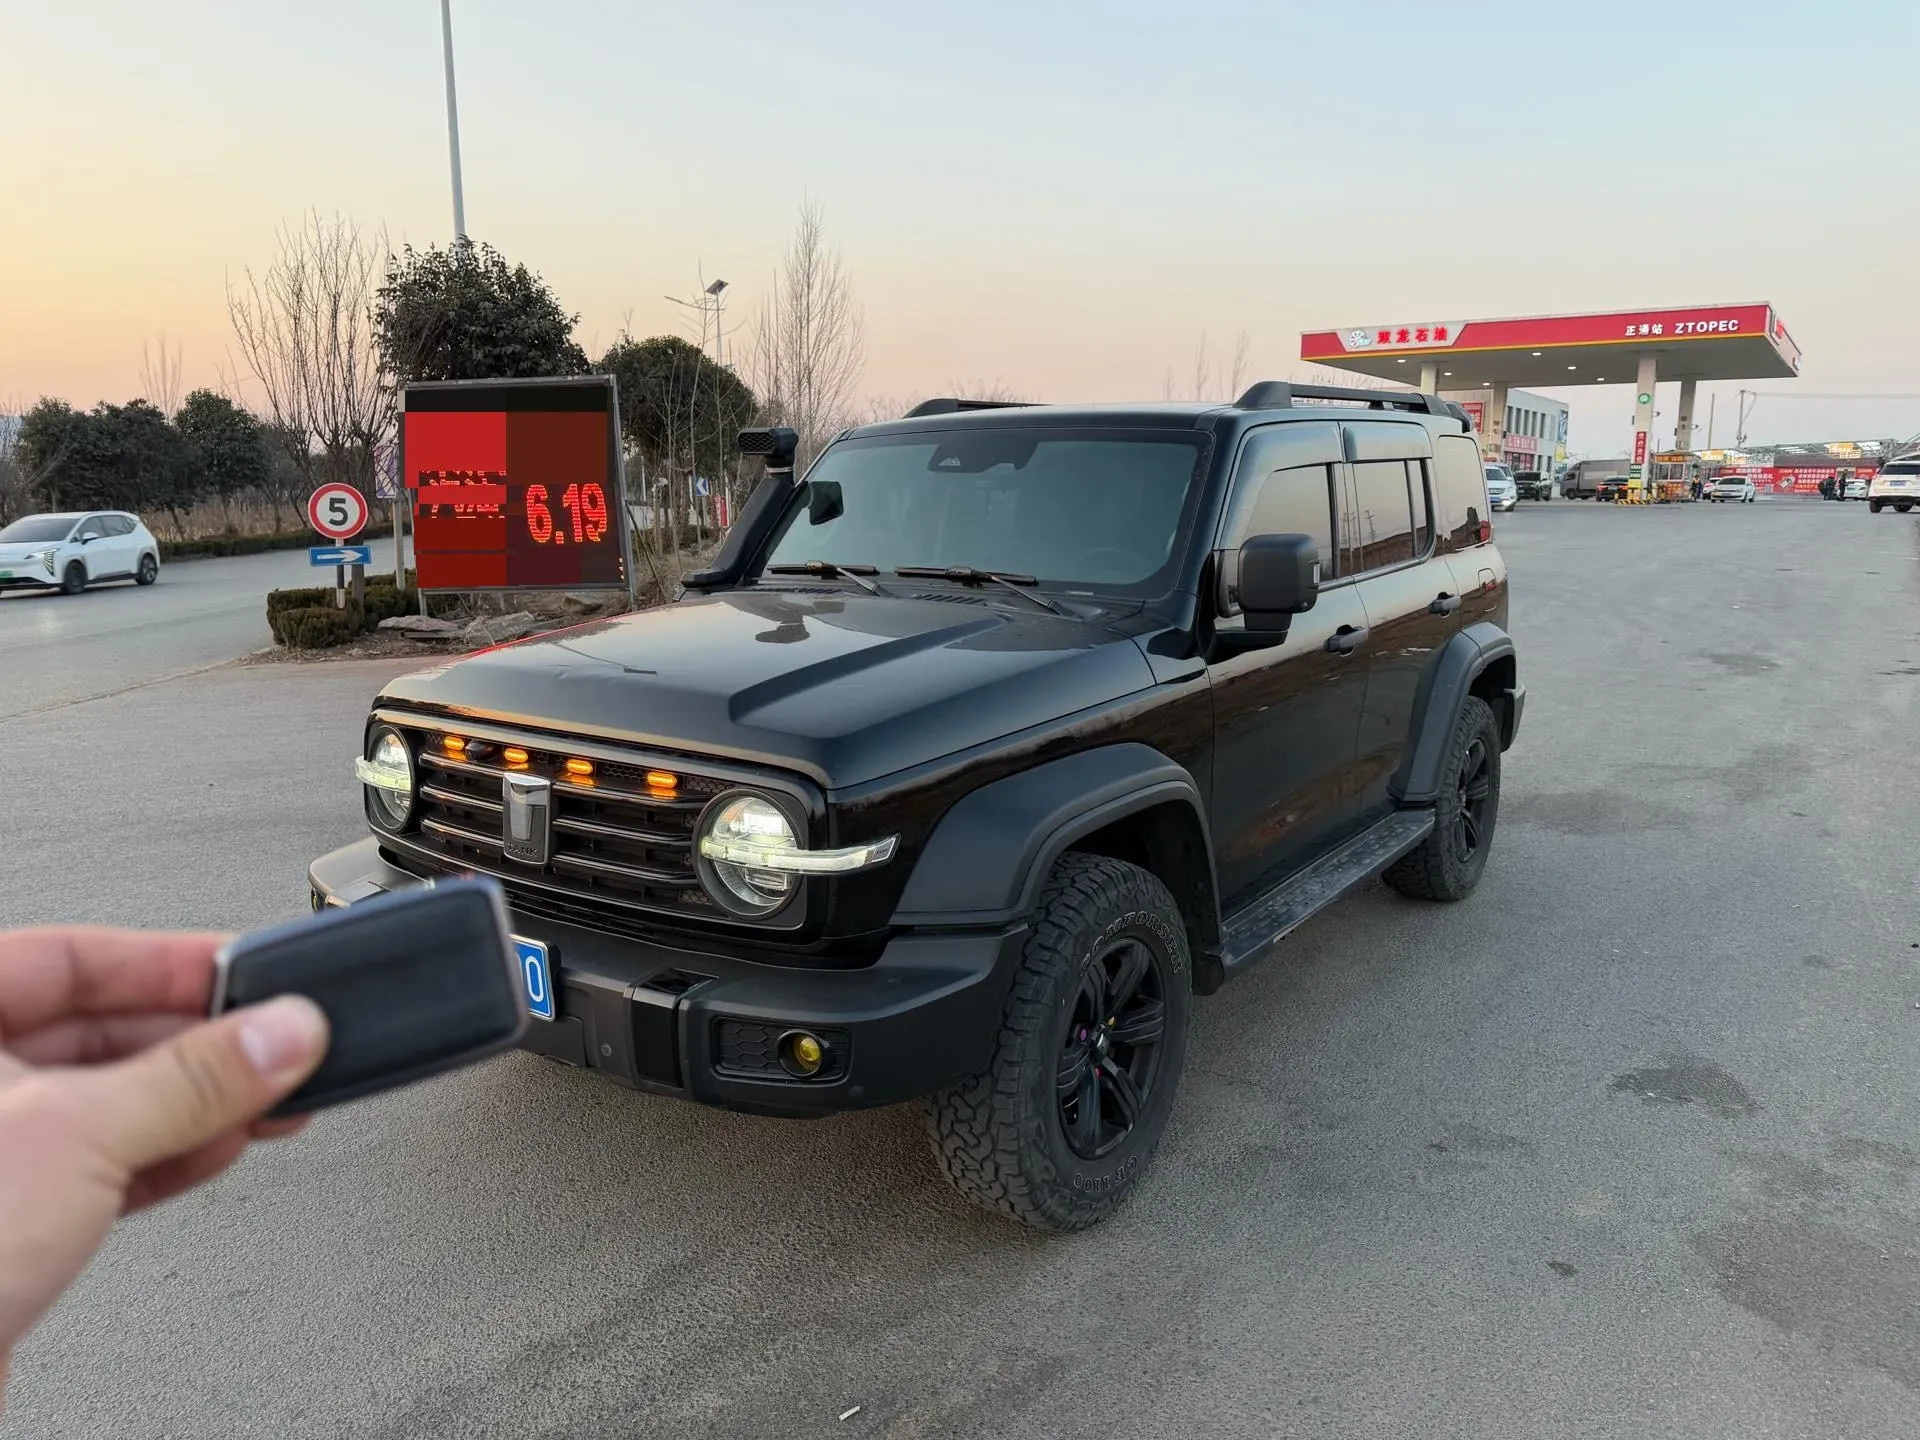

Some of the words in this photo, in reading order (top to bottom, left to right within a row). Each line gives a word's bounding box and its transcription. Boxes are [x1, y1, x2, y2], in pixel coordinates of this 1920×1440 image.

[1377, 326, 1448, 344] 双龙石油
[1675, 320, 1739, 334] ZTOPEC
[328, 497, 348, 526] 5
[527, 483, 607, 544] 6.19
[507, 843, 538, 858] TANK
[516, 955, 544, 1002] 0
